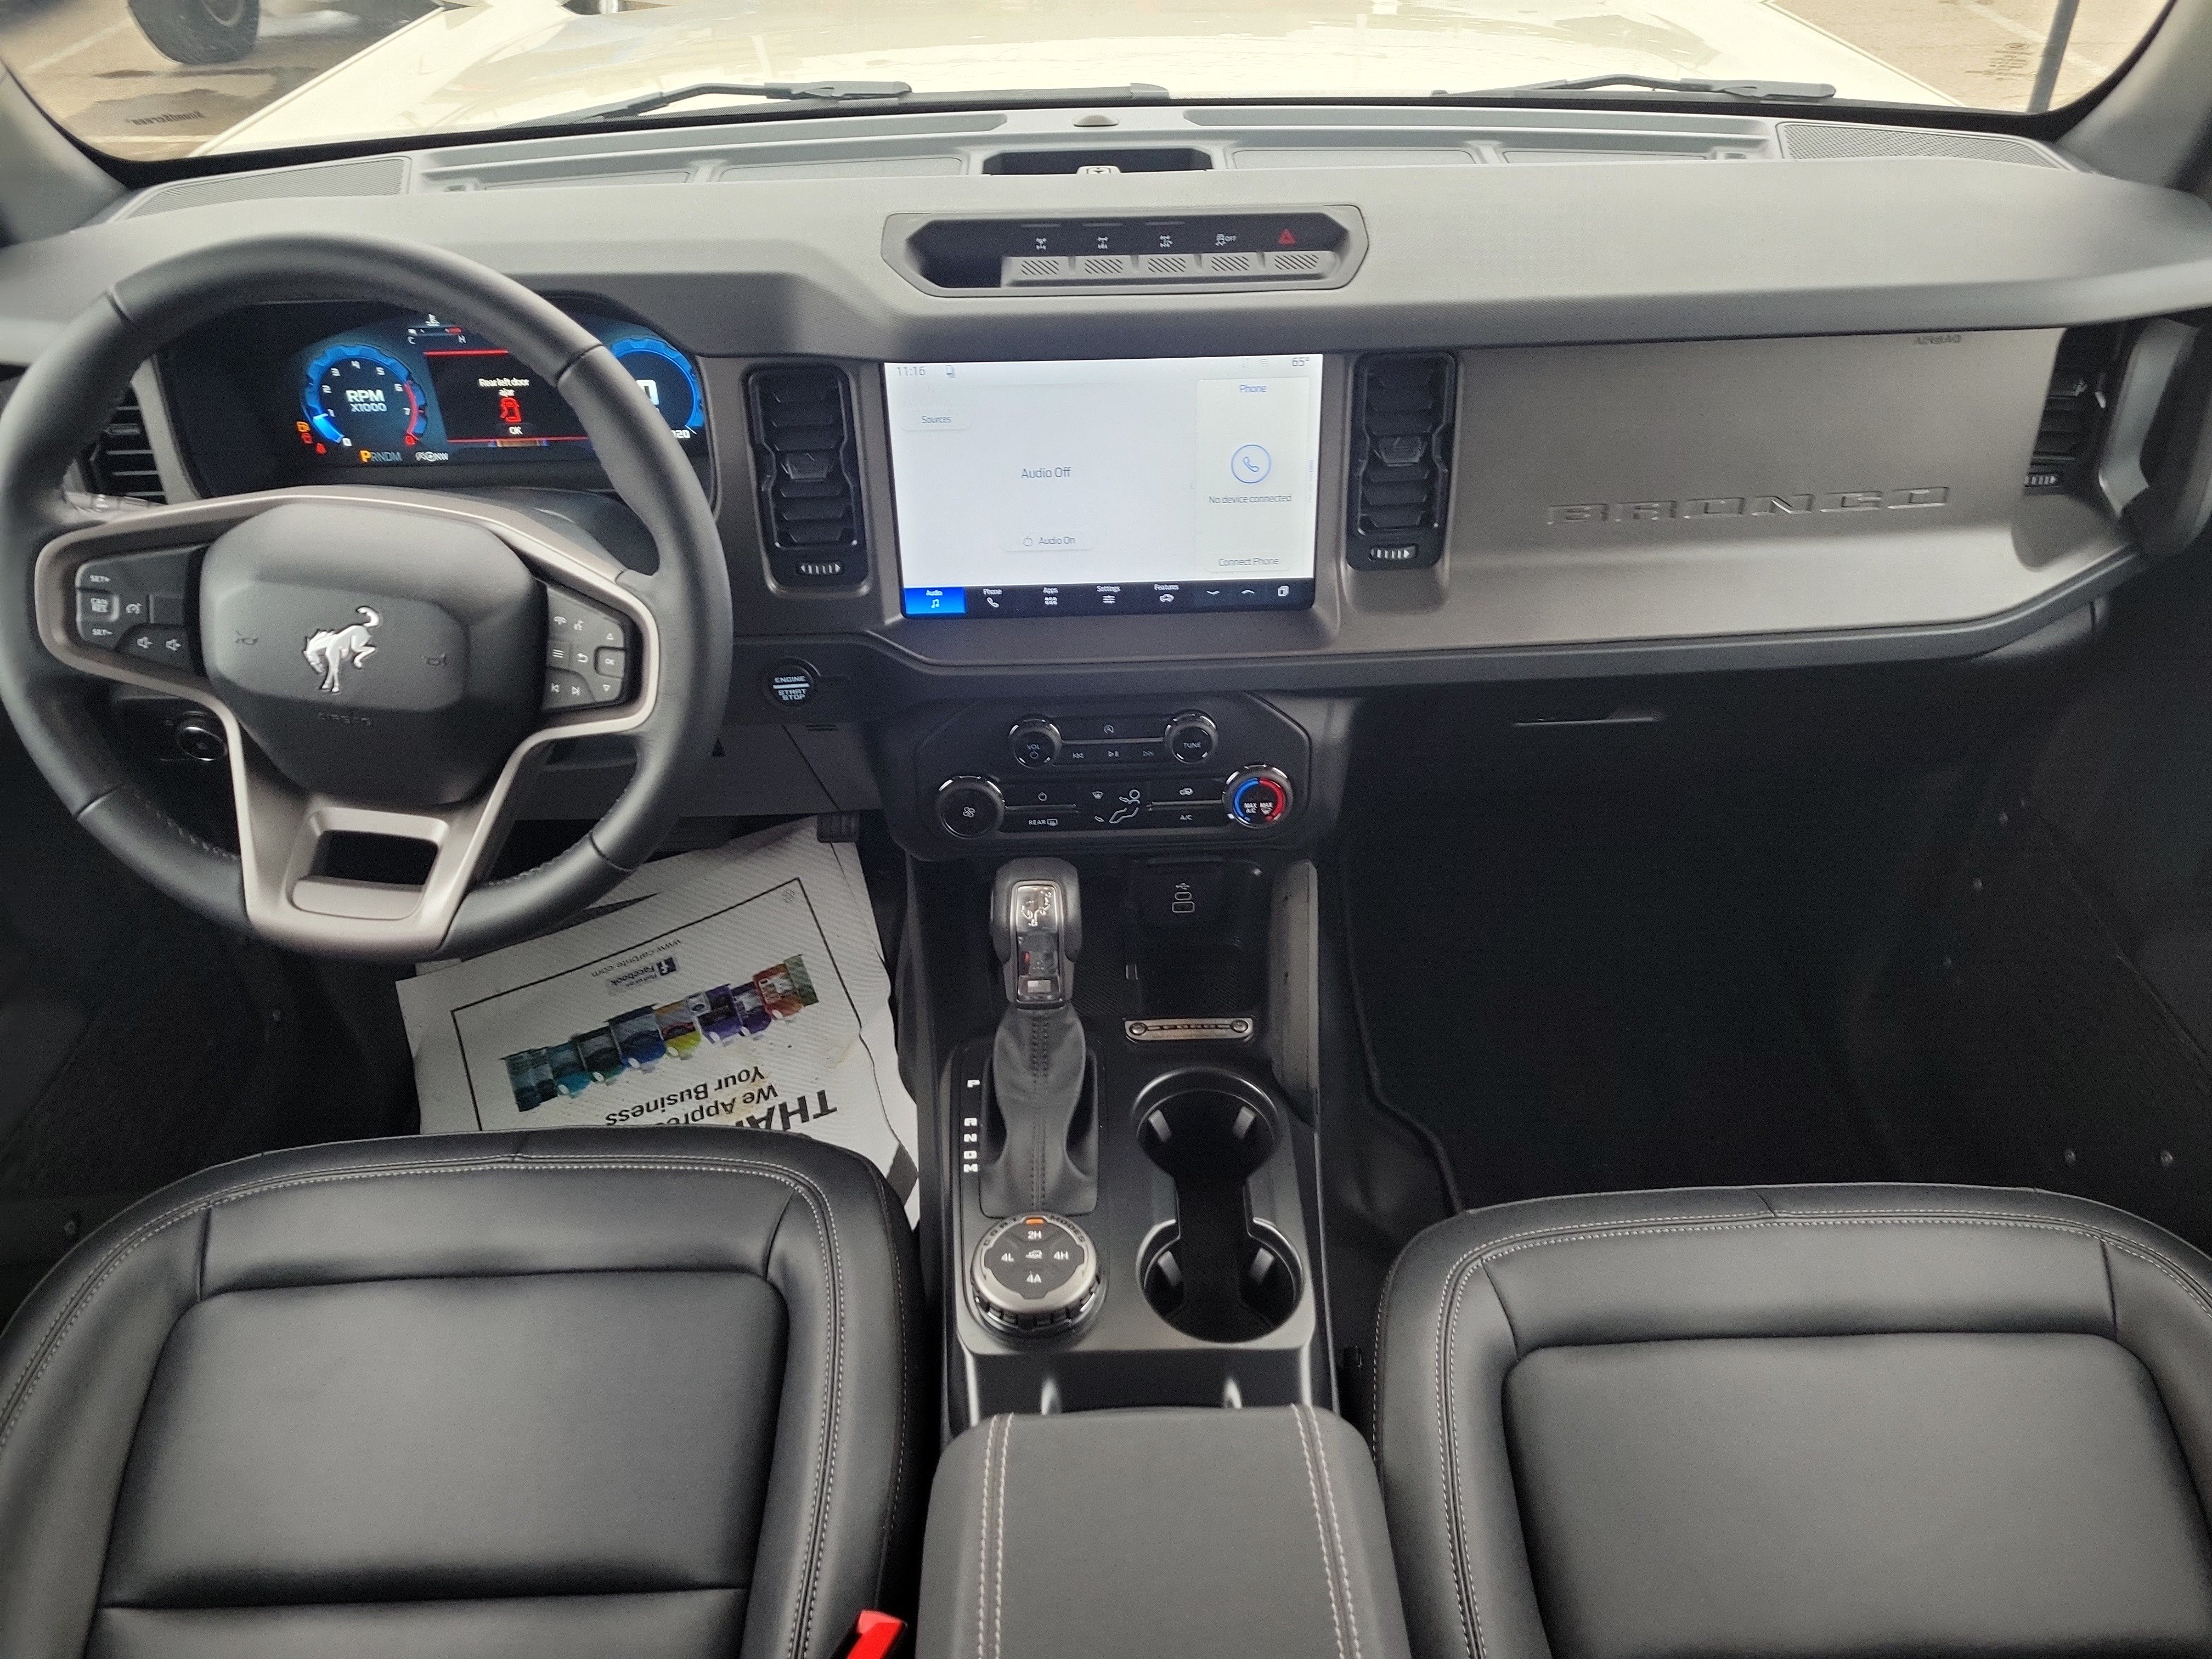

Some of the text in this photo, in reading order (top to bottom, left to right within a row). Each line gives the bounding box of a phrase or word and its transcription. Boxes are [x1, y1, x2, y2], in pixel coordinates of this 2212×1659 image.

[458, 335, 467, 344] H
[331, 368, 341, 377] 3
[376, 366, 385, 376] 5
[896, 365, 926, 376] 11:16
[479, 378, 497, 387] Rear
[322, 385, 332, 393] 2
[394, 383, 403, 392] 6
[1239, 384, 1267, 393] Phone
[346, 390, 385, 402] RPM
[349, 403, 387, 413] X1000
[921, 415, 952, 424] Sources
[509, 426, 523, 435] OK
[342, 438, 352, 447] 0
[1021, 467, 1072, 478] Audio Off
[1209, 494, 1292, 504] No device connected
[1547, 487, 1950, 526] BRONCO
[1039, 535, 1076, 545] Audio On
[1218, 557, 1279, 567] Connect Phone
[1043, 586, 1059, 595] Apps
[1097, 585, 1121, 593] Settings
[610, 965, 655, 986] Facebook
[967, 1080, 980, 1088] P
[605, 1066, 766, 1126] Your Business
[742, 1084, 778, 1104] We
[964, 1118, 978, 1126] R
[964, 1133, 977, 1142] N
[964, 1150, 977, 1159] D
[964, 1164, 978, 1172] M
[1050, 1215, 1086, 1243] MODES
[1028, 1231, 1042, 1240] 2H
[1001, 1252, 1014, 1262] 4L
[1053, 1250, 1069, 1260] 4H
[1026, 1273, 1042, 1284] 4A
